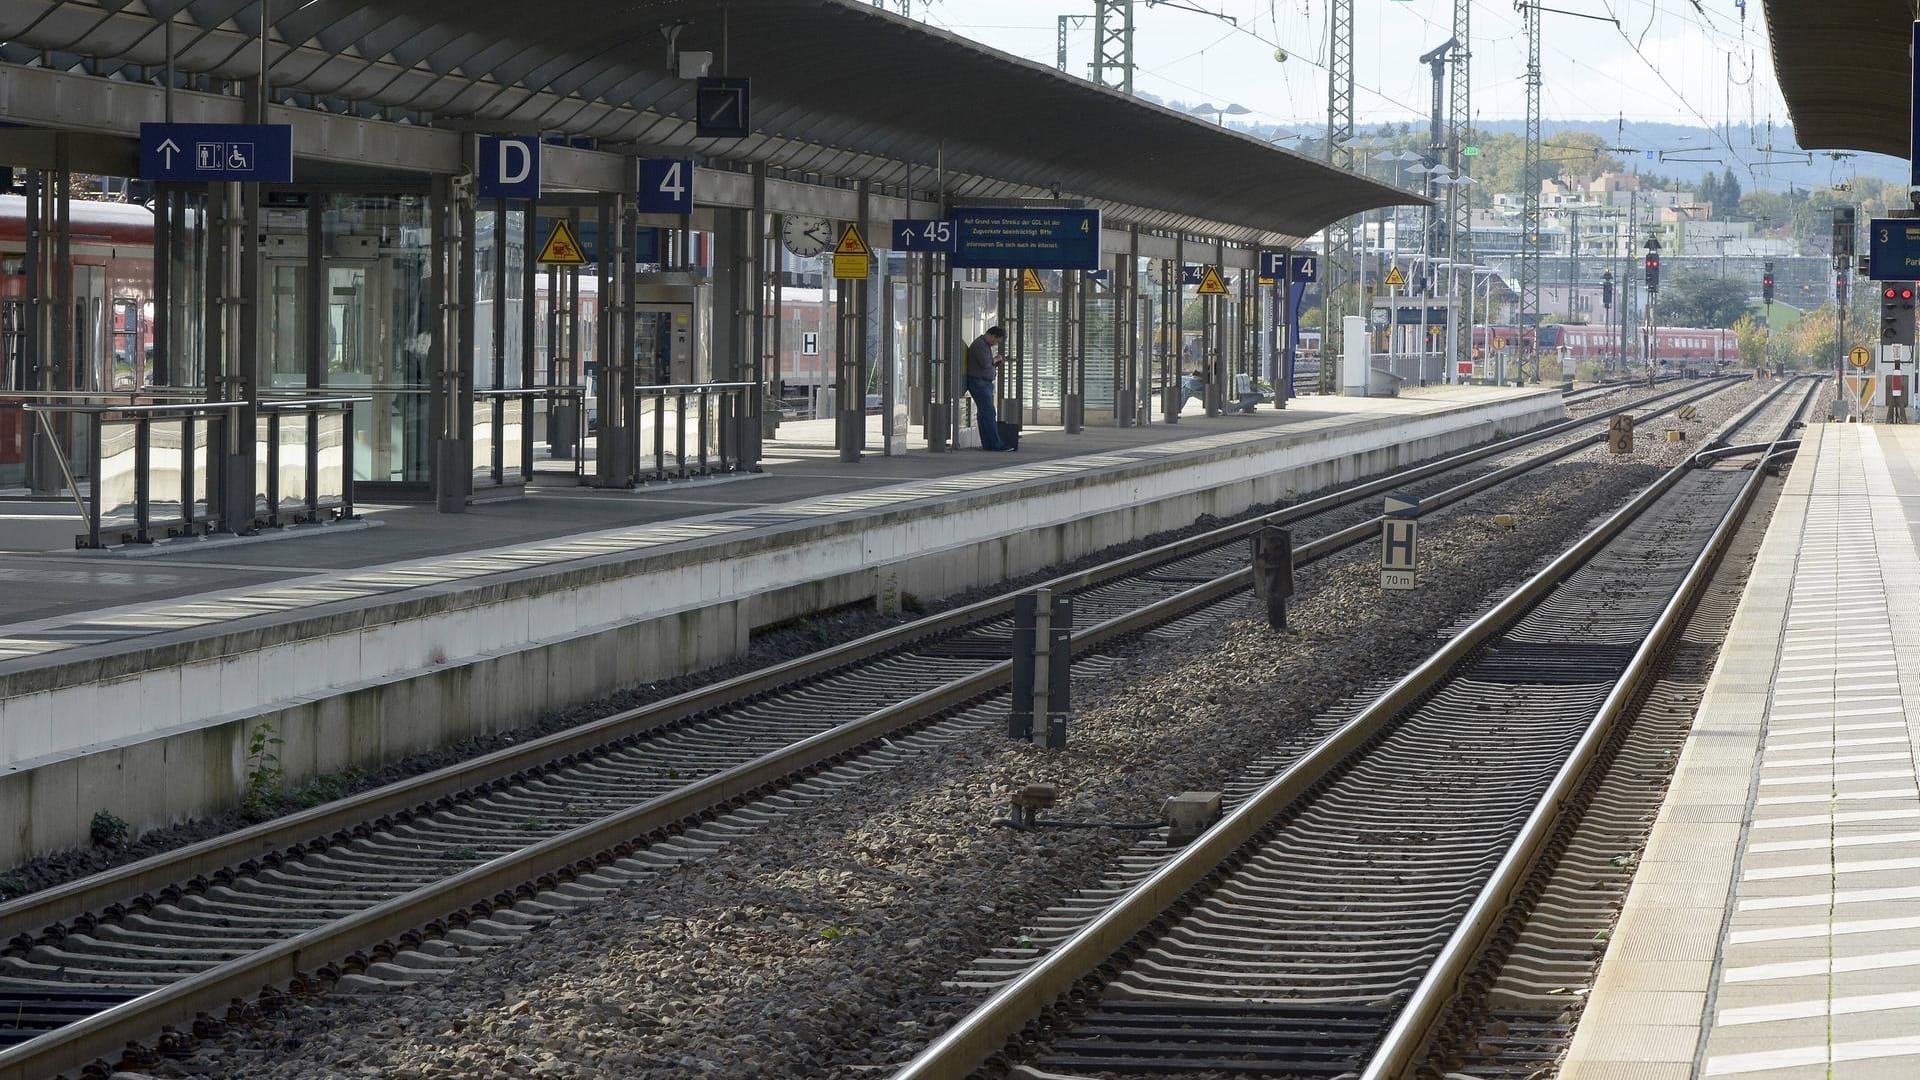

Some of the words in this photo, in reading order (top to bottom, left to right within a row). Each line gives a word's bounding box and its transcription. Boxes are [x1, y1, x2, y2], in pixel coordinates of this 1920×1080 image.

[499, 140, 531, 184] D
[660, 162, 685, 201] 4
[923, 221, 950, 242] 45
[972, 227, 1001, 236] Zugverkehr
[1081, 219, 1089, 233] 4
[995, 240, 1004, 248] Sie
[1880, 229, 1889, 243] 3
[1271, 254, 1284, 273] F
[1301, 258, 1314, 277] 4
[804, 333, 817, 353] H
[1612, 415, 1632, 433] 43
[1617, 434, 1628, 450] 6
[1386, 523, 1414, 565] H
[1386, 575, 1398, 585] 70
[1400, 577, 1410, 585] m
